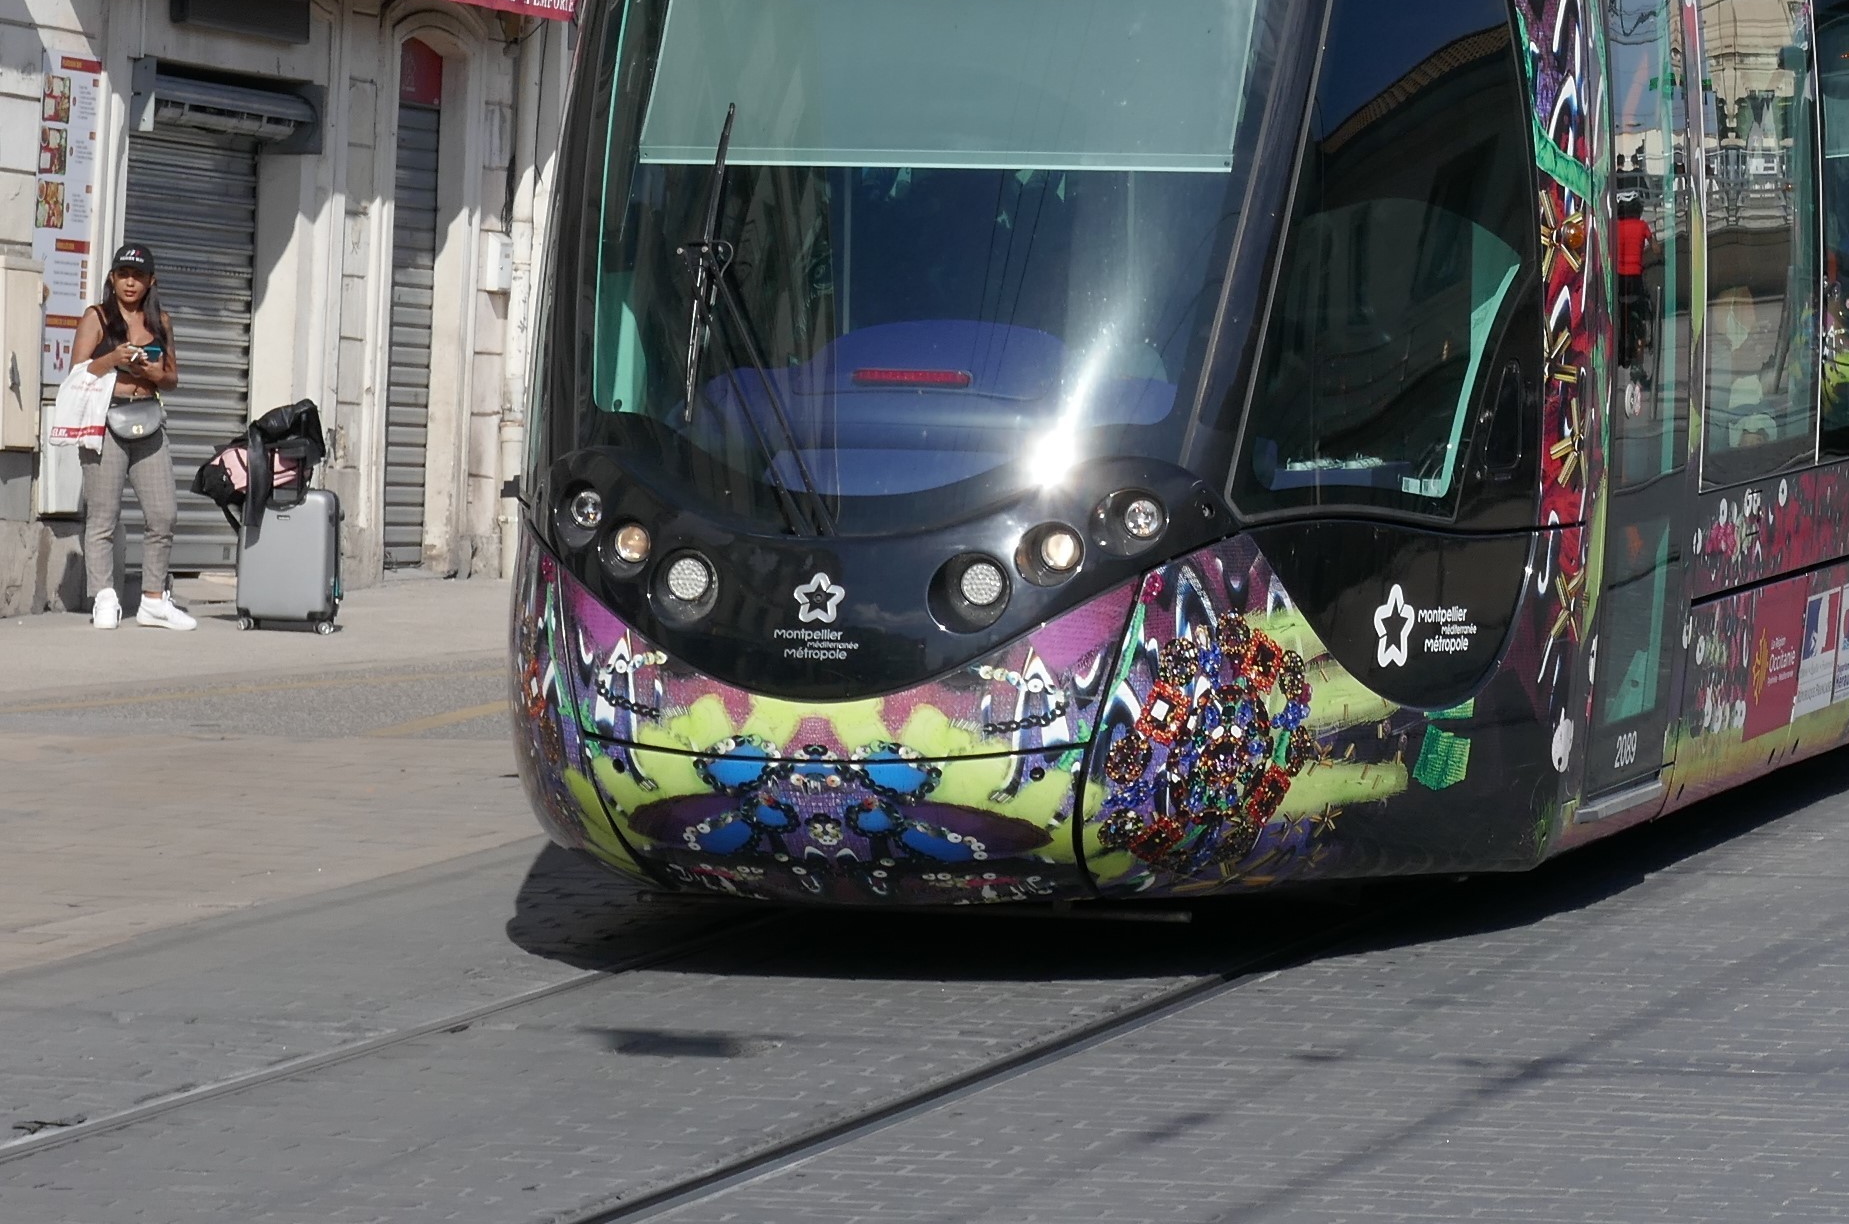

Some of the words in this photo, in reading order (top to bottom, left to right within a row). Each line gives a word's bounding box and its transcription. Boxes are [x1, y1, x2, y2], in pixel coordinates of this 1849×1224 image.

[1417, 605, 1468, 626] Montpellier
[773, 627, 844, 642] Montpellier
[1423, 634, 1469, 655] Métropole
[783, 646, 848, 661] Métropole
[1769, 645, 1796, 673] Occitanie
[1614, 730, 1638, 769] 2089
